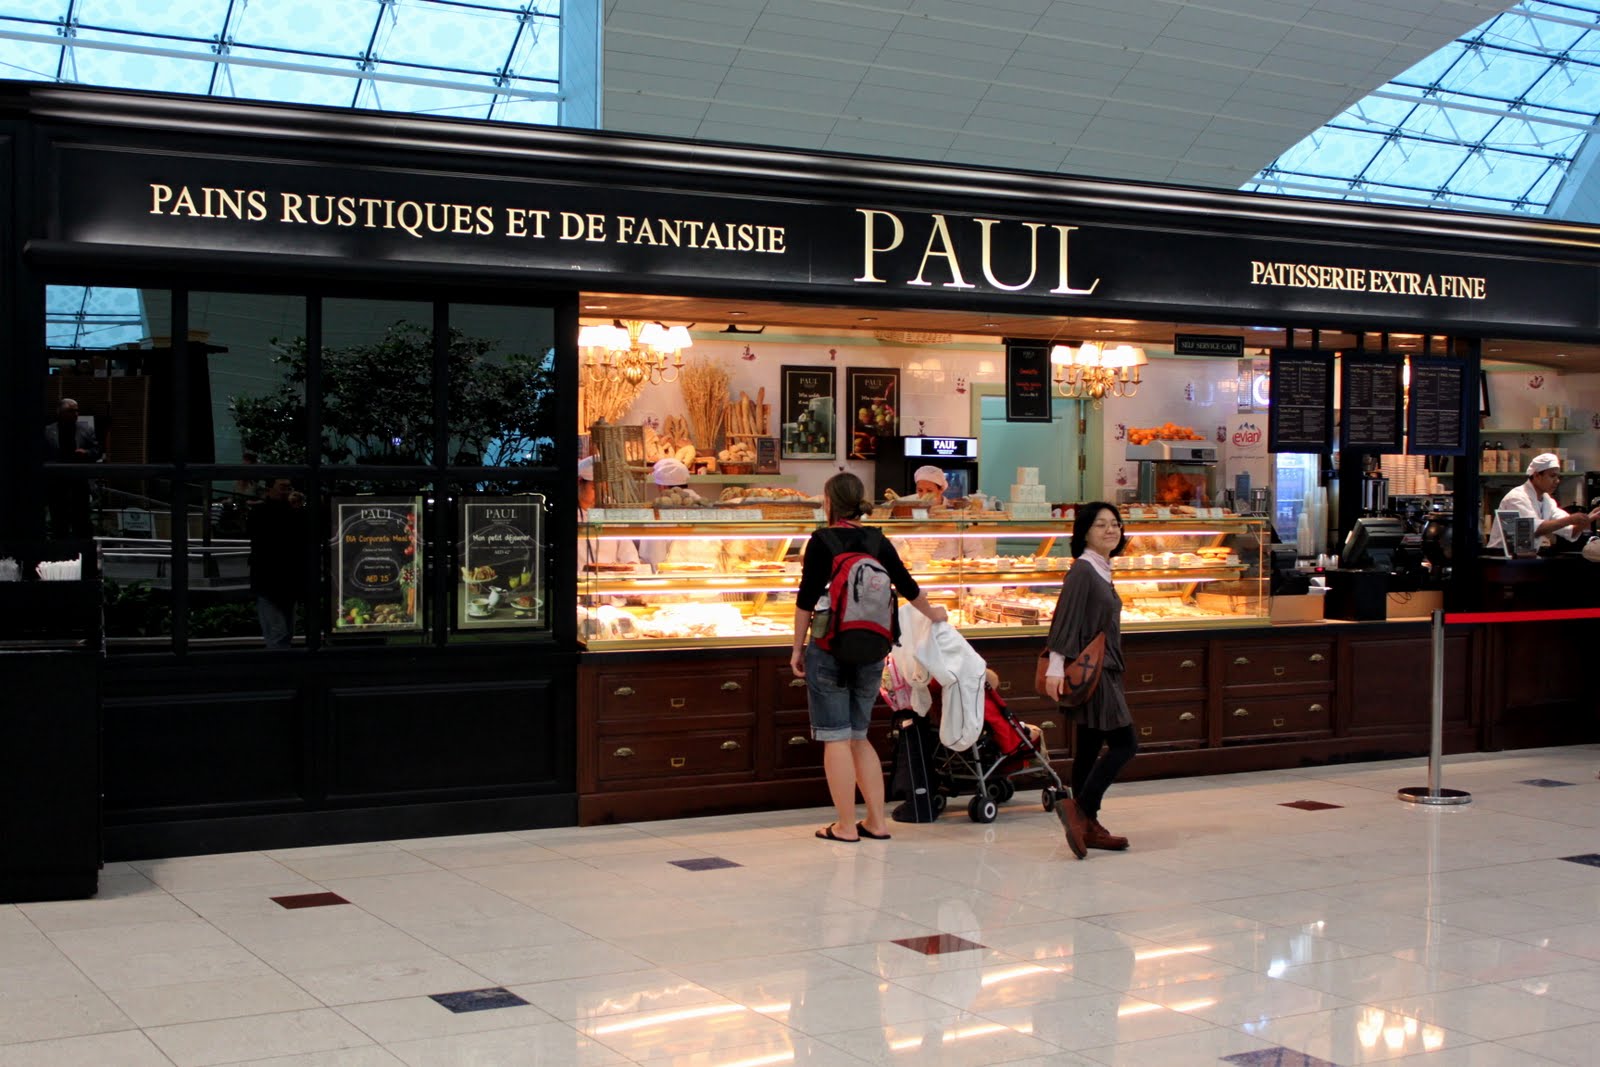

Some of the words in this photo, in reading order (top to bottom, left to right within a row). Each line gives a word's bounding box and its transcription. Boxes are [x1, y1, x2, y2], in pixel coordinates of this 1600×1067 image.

[149, 184, 268, 222] PAINS
[280, 192, 495, 238] RUSTIQUES
[505, 208, 550, 239] ET
[560, 211, 608, 243] DE
[616, 215, 787, 254] FANTAISIE
[853, 208, 1100, 295] PAUL
[1250, 260, 1366, 292] PATISSERIE
[1368, 269, 1438, 297] EXTRA
[1440, 274, 1487, 300] FINE
[1181, 341, 1195, 349] SELF
[1196, 342, 1221, 350] SERVICE
[1234, 431, 1260, 443] evian
[933, 440, 958, 450] PAUL
[360, 508, 394, 519] PAUL
[485, 508, 518, 519] PAUL
[358, 535, 390, 545] Corporate
